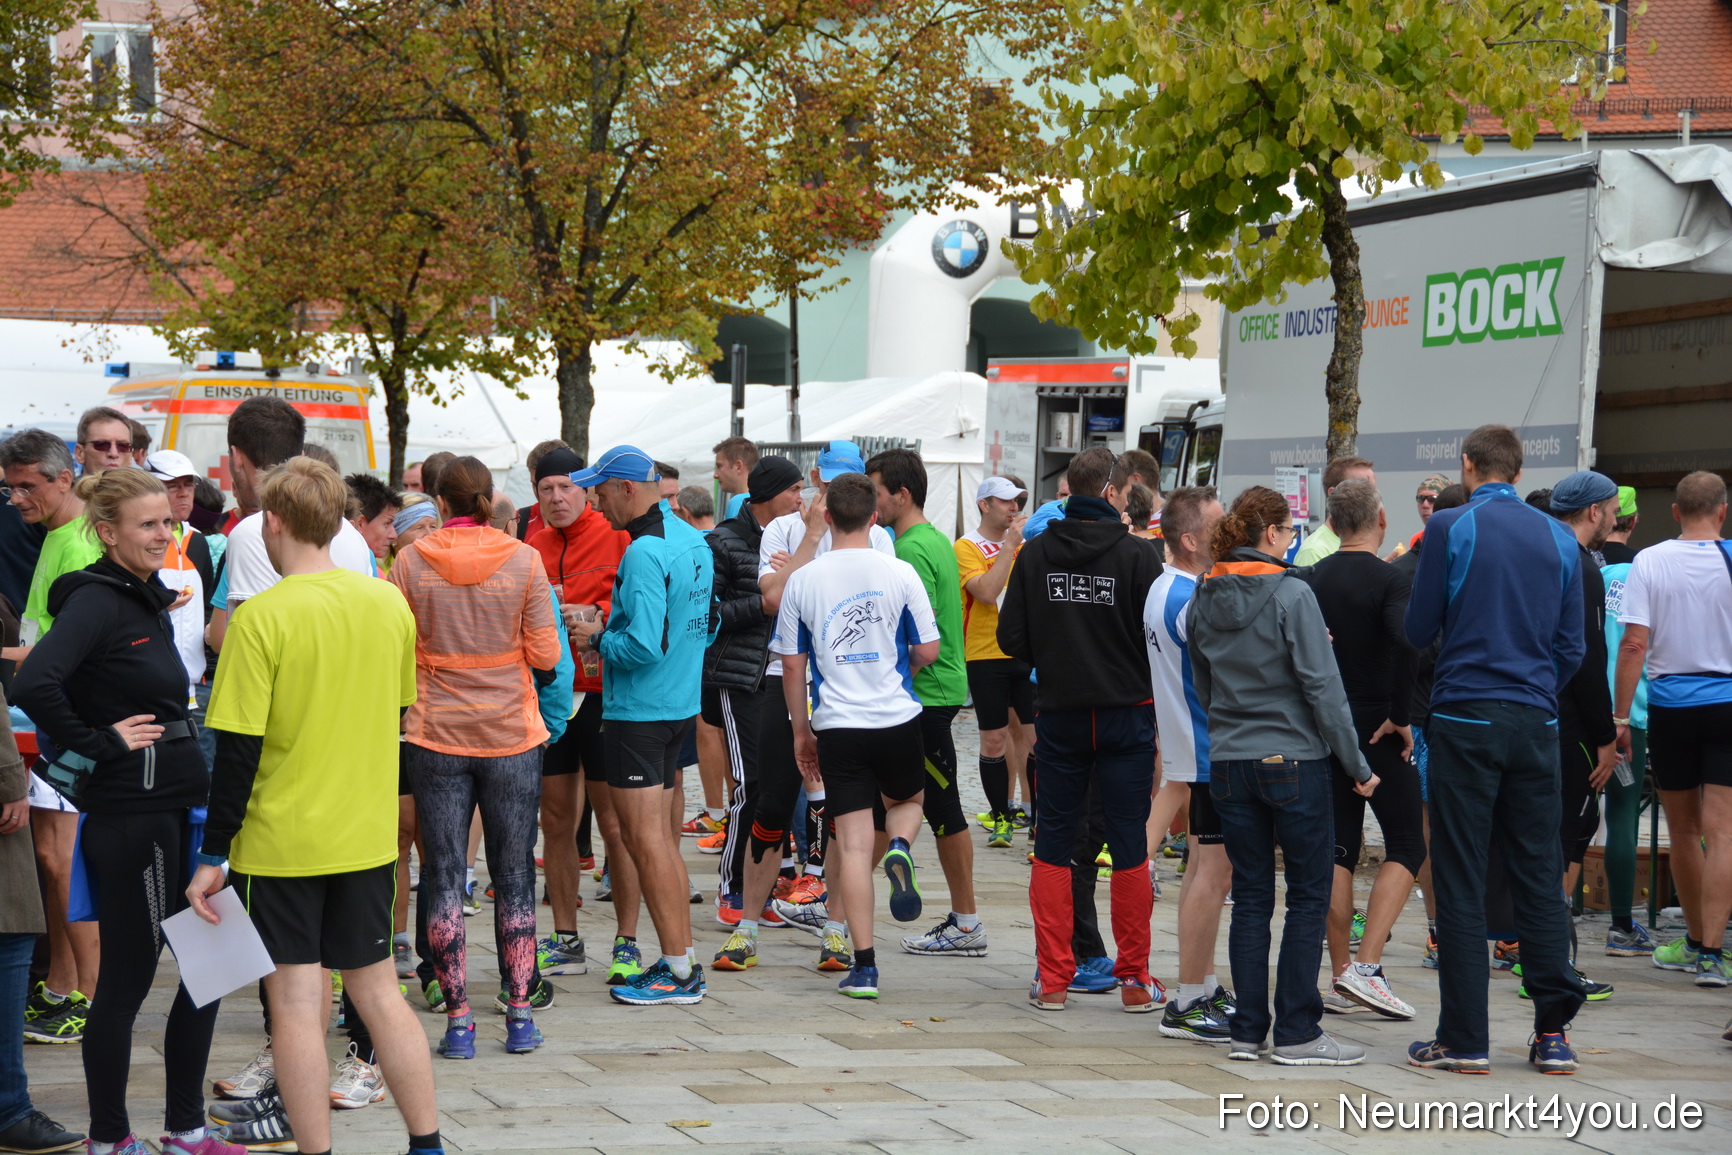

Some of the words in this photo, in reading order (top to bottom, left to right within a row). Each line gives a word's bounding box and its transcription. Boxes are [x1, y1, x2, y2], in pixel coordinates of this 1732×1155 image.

[1425, 263, 1560, 342] BOCK
[1239, 313, 1280, 343] OFFICE
[1362, 295, 1410, 330] OUNGE
[204, 385, 344, 403] EINSATZLEITUNG
[1416, 438, 1457, 463] inspired
[1522, 435, 1561, 460] ncepts
[1079, 577, 1086, 585] &
[1096, 578, 1111, 588] bike
[820, 612, 834, 641] ERFOLG
[831, 596, 852, 616] DURCH
[852, 590, 884, 602] LEISTUNG
